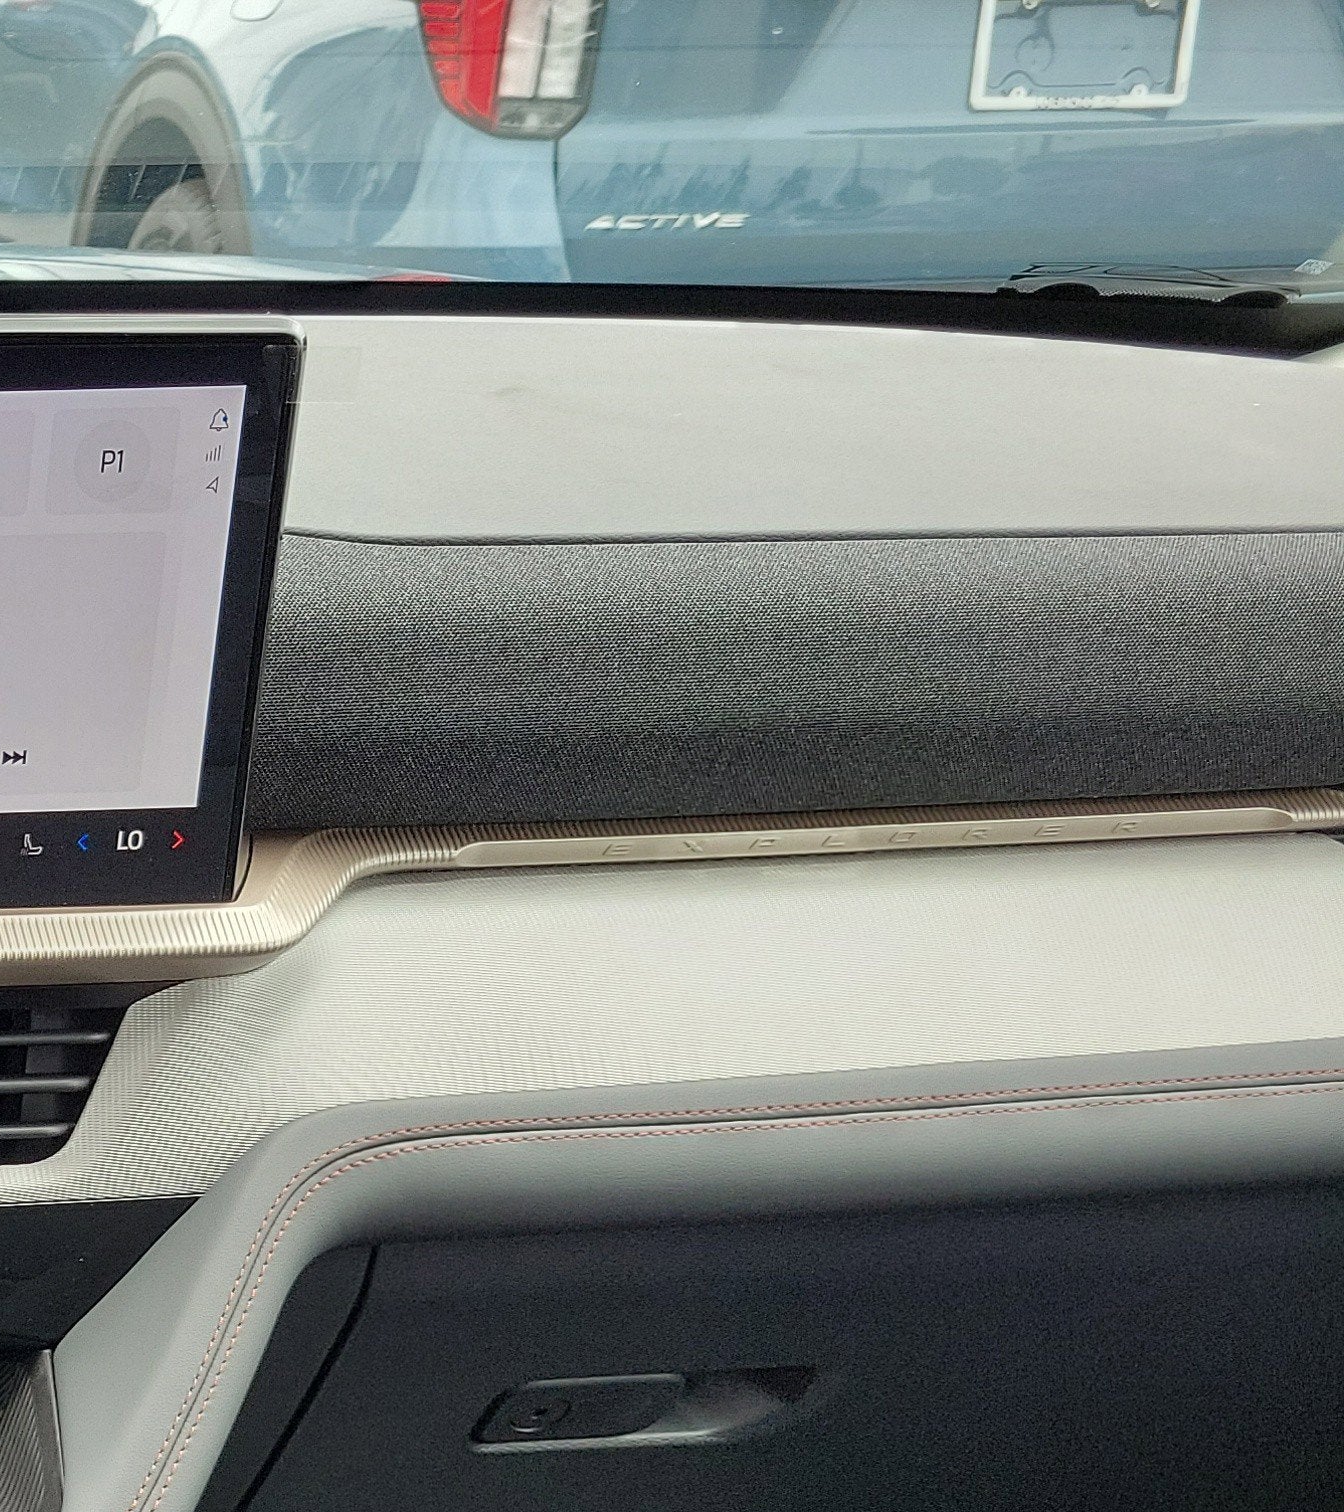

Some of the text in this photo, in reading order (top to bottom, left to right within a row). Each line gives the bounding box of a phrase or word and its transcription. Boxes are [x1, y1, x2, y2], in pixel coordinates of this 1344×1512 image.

[584, 211, 751, 231] ACTIVE
[100, 448, 125, 474] P1
[116, 830, 144, 851] LO
